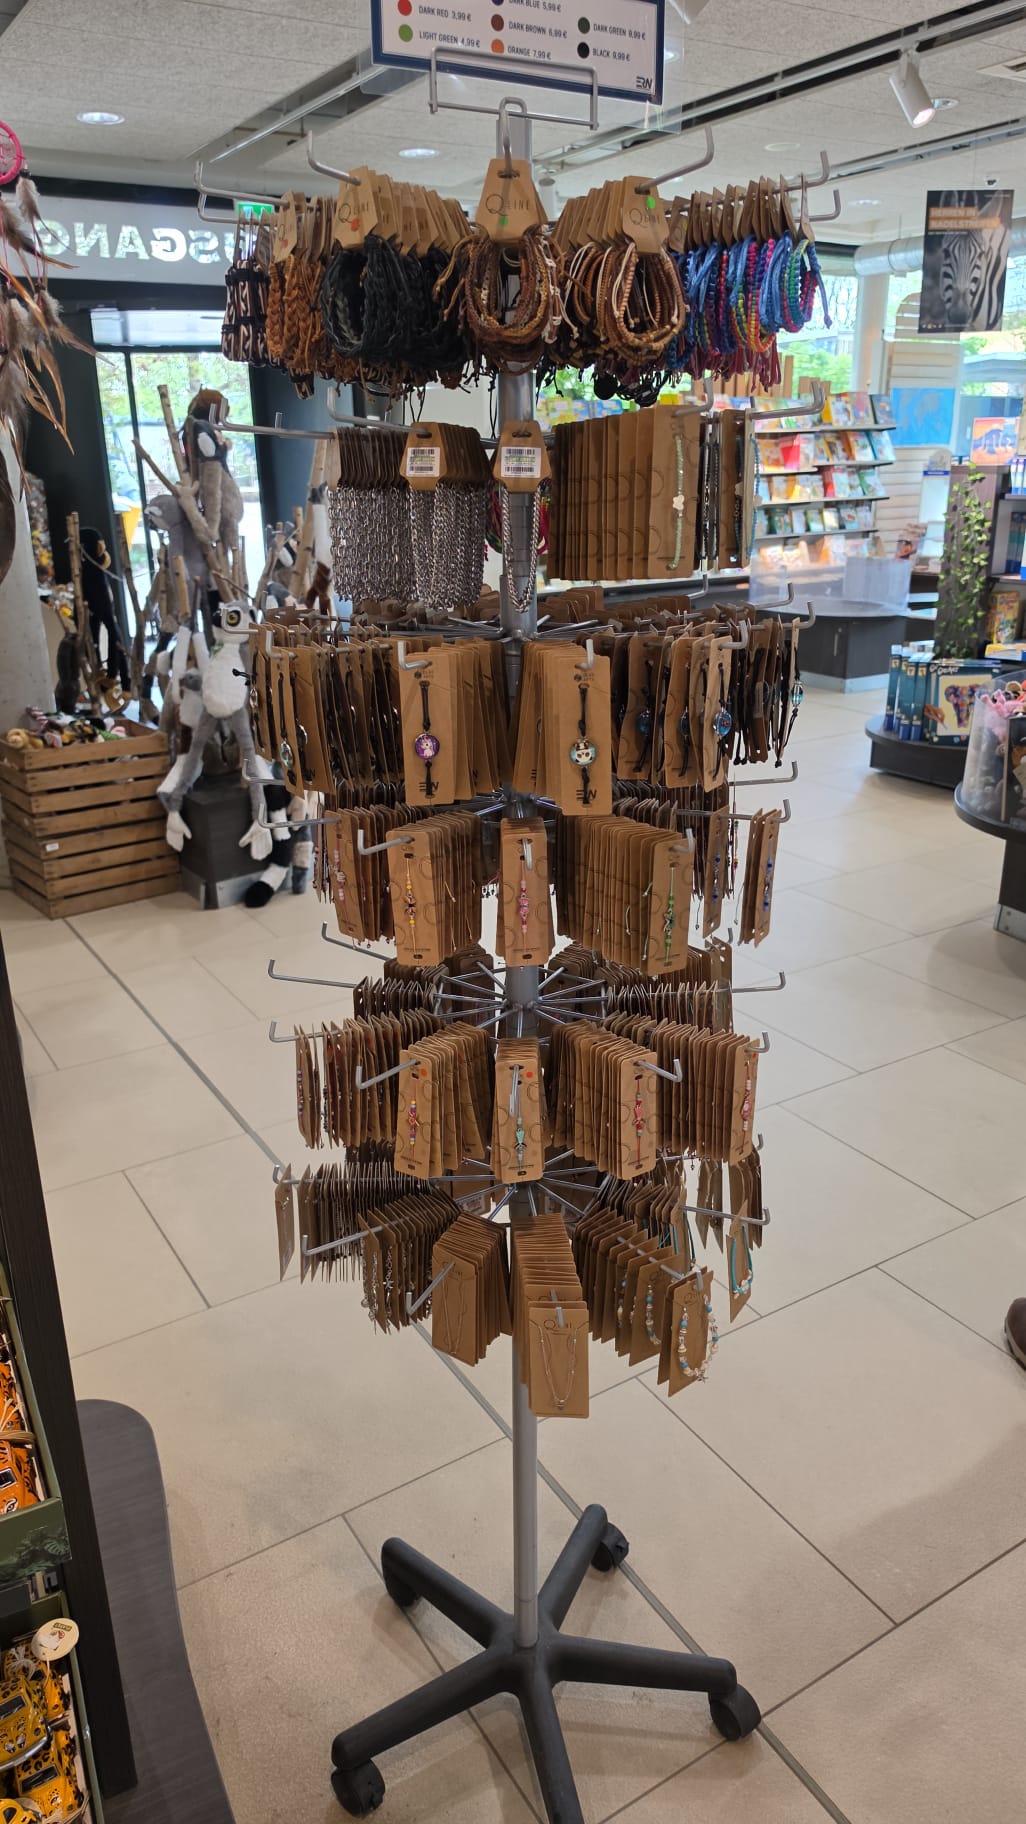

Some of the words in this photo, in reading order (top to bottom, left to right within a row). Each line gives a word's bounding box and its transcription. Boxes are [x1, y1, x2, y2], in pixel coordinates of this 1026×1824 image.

[418, 5, 435, 16] DARK
[437, 8, 449, 18] RED
[452, 11, 466, 21] 3,99
[466, 13, 472, 22] €
[526, 0, 540, 8] BLUE
[556, 4, 562, 12] €
[508, 21, 524, 32] DARK
[525, 24, 546, 35] BROWN
[562, 30, 568, 39] €
[593, 23, 608, 32] DARK
[609, 25, 627, 36] GREEN
[641, 32, 646, 40] €
[419, 31, 437, 41] LIGHT
[438, 34, 458, 44] GREEN
[461, 38, 475, 47] 4,99
[475, 40, 481, 48] €
[507, 46, 531, 57] ORANGE
[546, 52, 552, 60] €
[592, 48, 610, 58] BLACK
[625, 53, 631, 62] €
[635, 76, 653, 90] ERN
